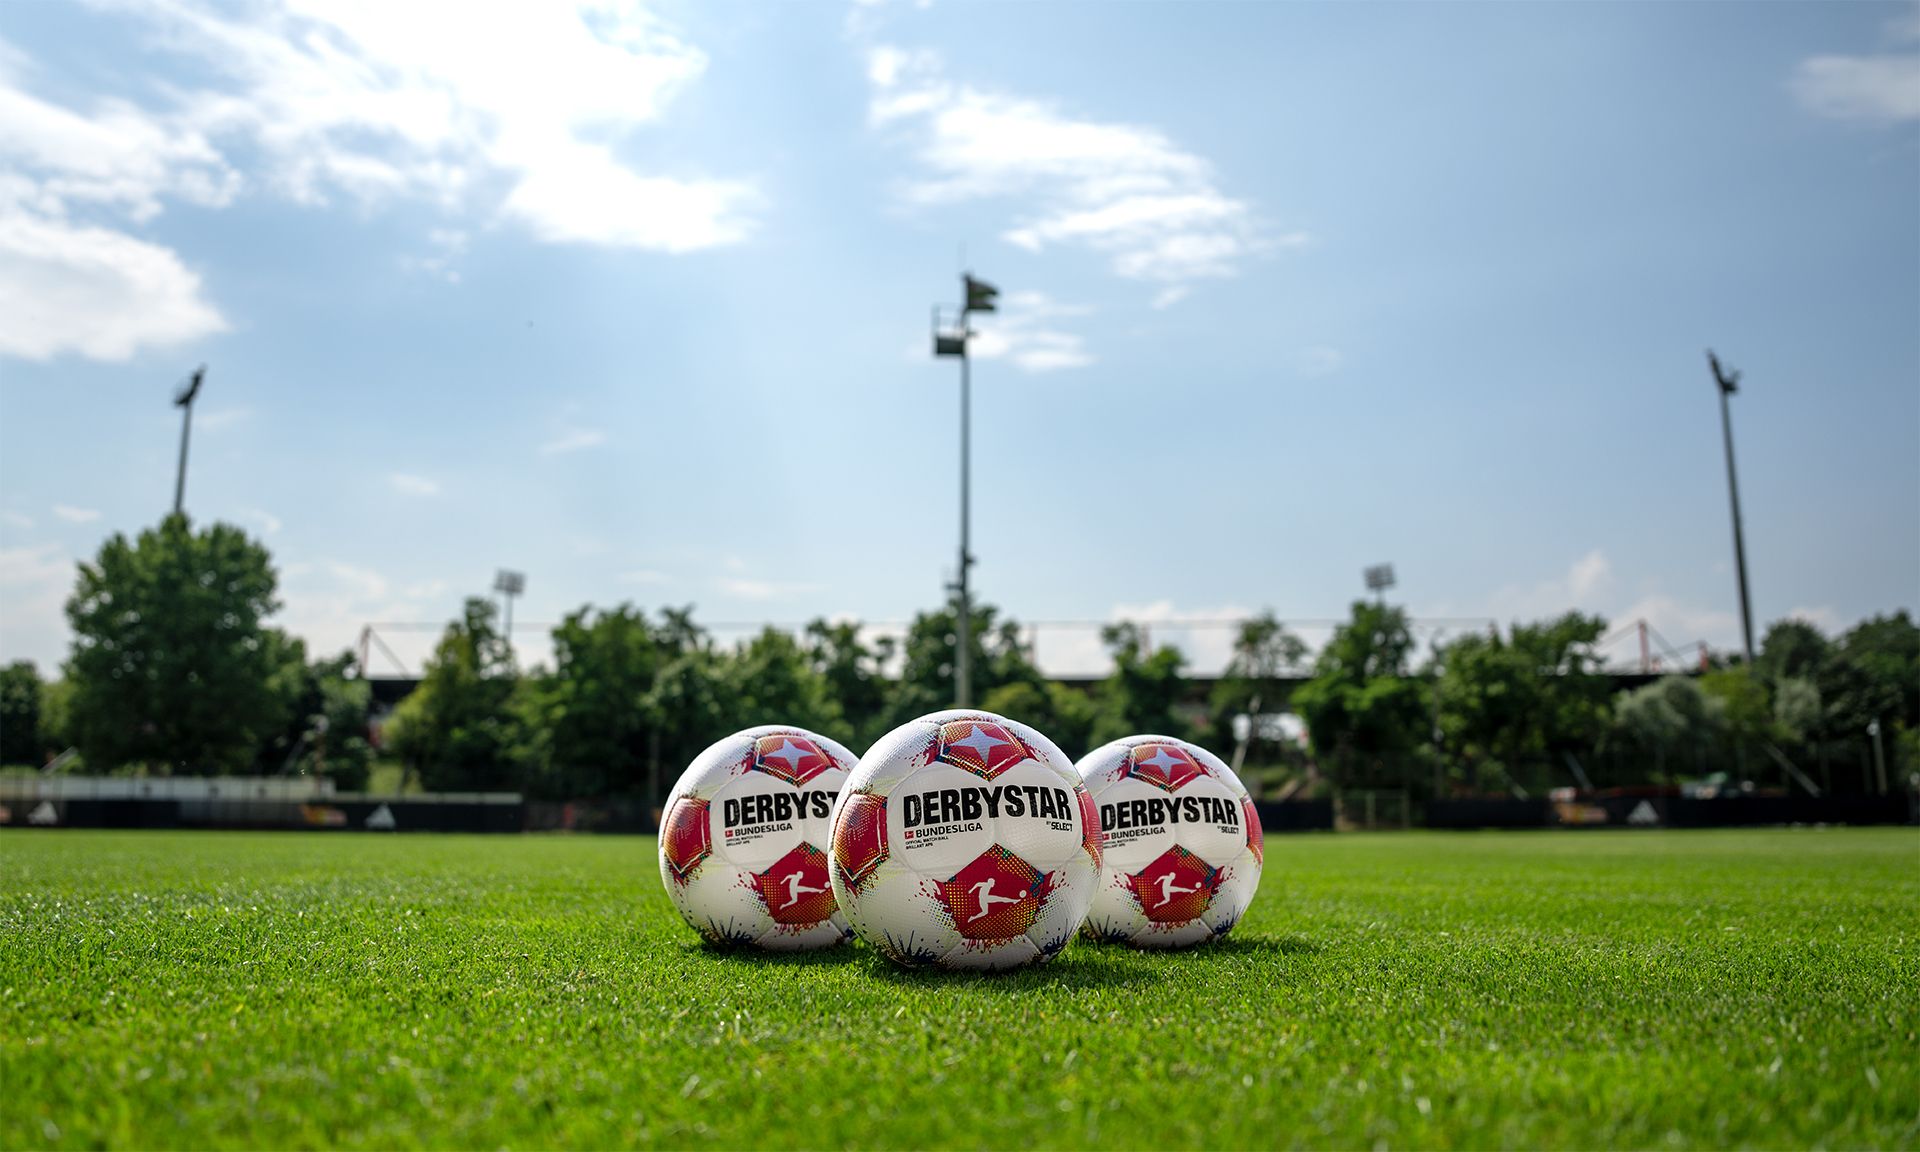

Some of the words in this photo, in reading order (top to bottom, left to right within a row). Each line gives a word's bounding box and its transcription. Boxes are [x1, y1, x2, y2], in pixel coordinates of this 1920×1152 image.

[903, 785, 1073, 828] DERBYSTAR
[1101, 796, 1239, 832] DERBYSTAR
[735, 823, 793, 836] BUNDESLIGA
[916, 823, 983, 838] BUNDESLIGA
[1050, 821, 1073, 831] SELECT
[1111, 827, 1166, 839] BUNDESLIGA
